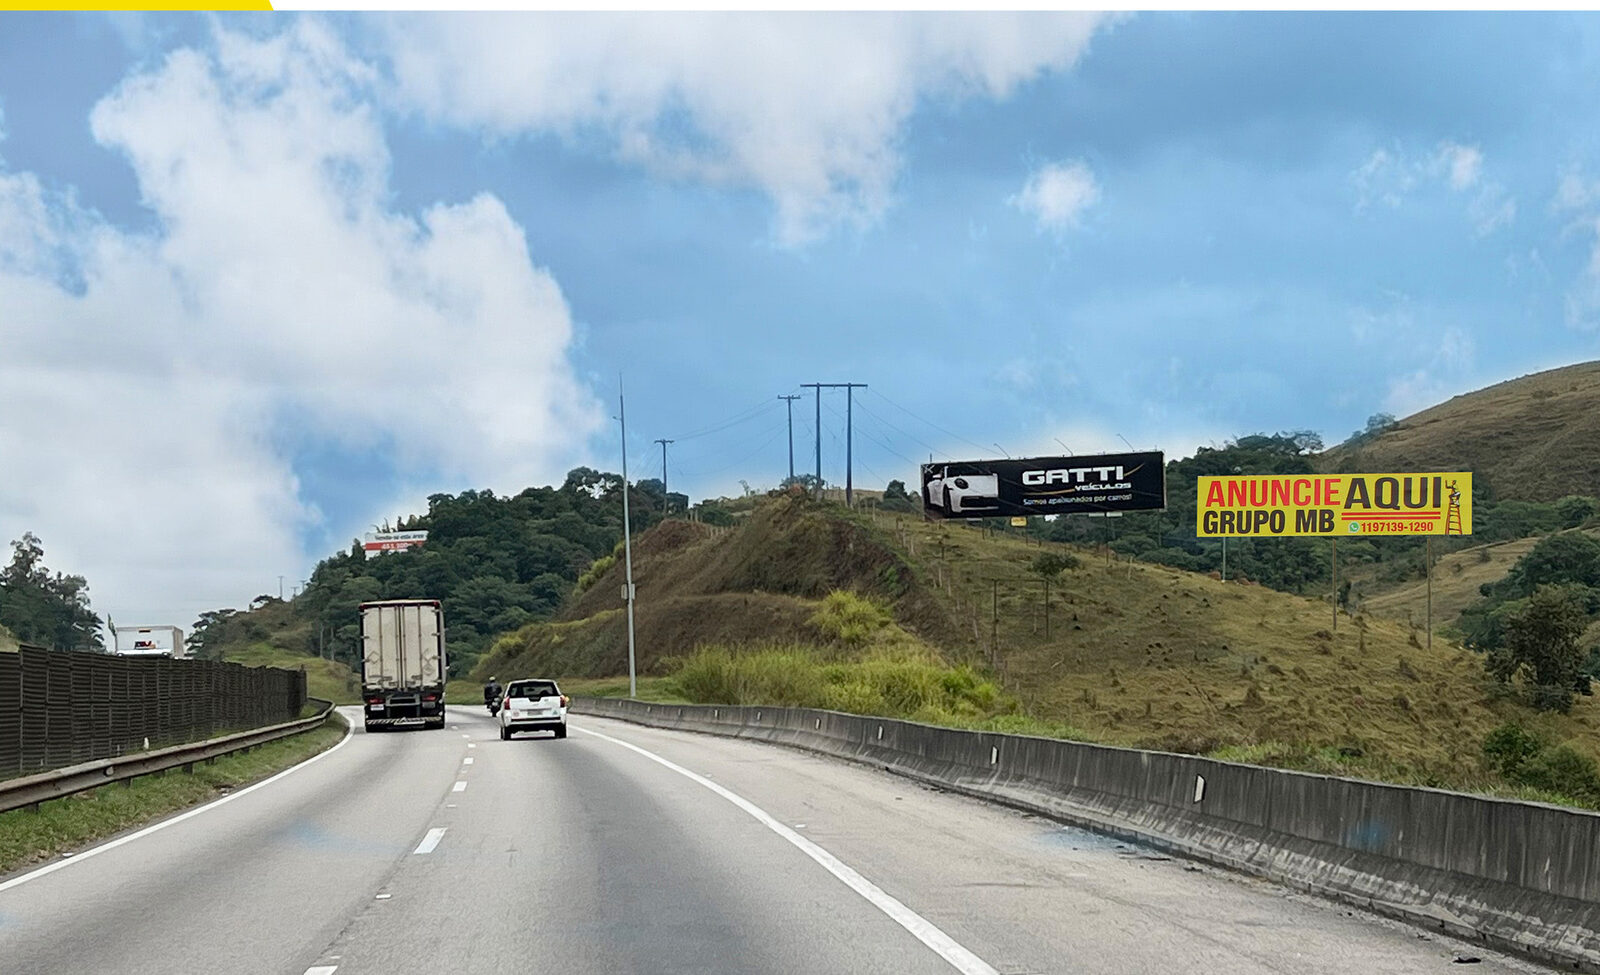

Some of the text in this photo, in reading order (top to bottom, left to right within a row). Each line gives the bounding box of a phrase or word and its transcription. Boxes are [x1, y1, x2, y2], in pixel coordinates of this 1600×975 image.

[1022, 466, 1124, 485] GATTI
[1205, 477, 1441, 510] ANUNCIE AQUI
[1203, 509, 1335, 534] GRUPO MB
[1361, 522, 1434, 532] 1197139-1290
